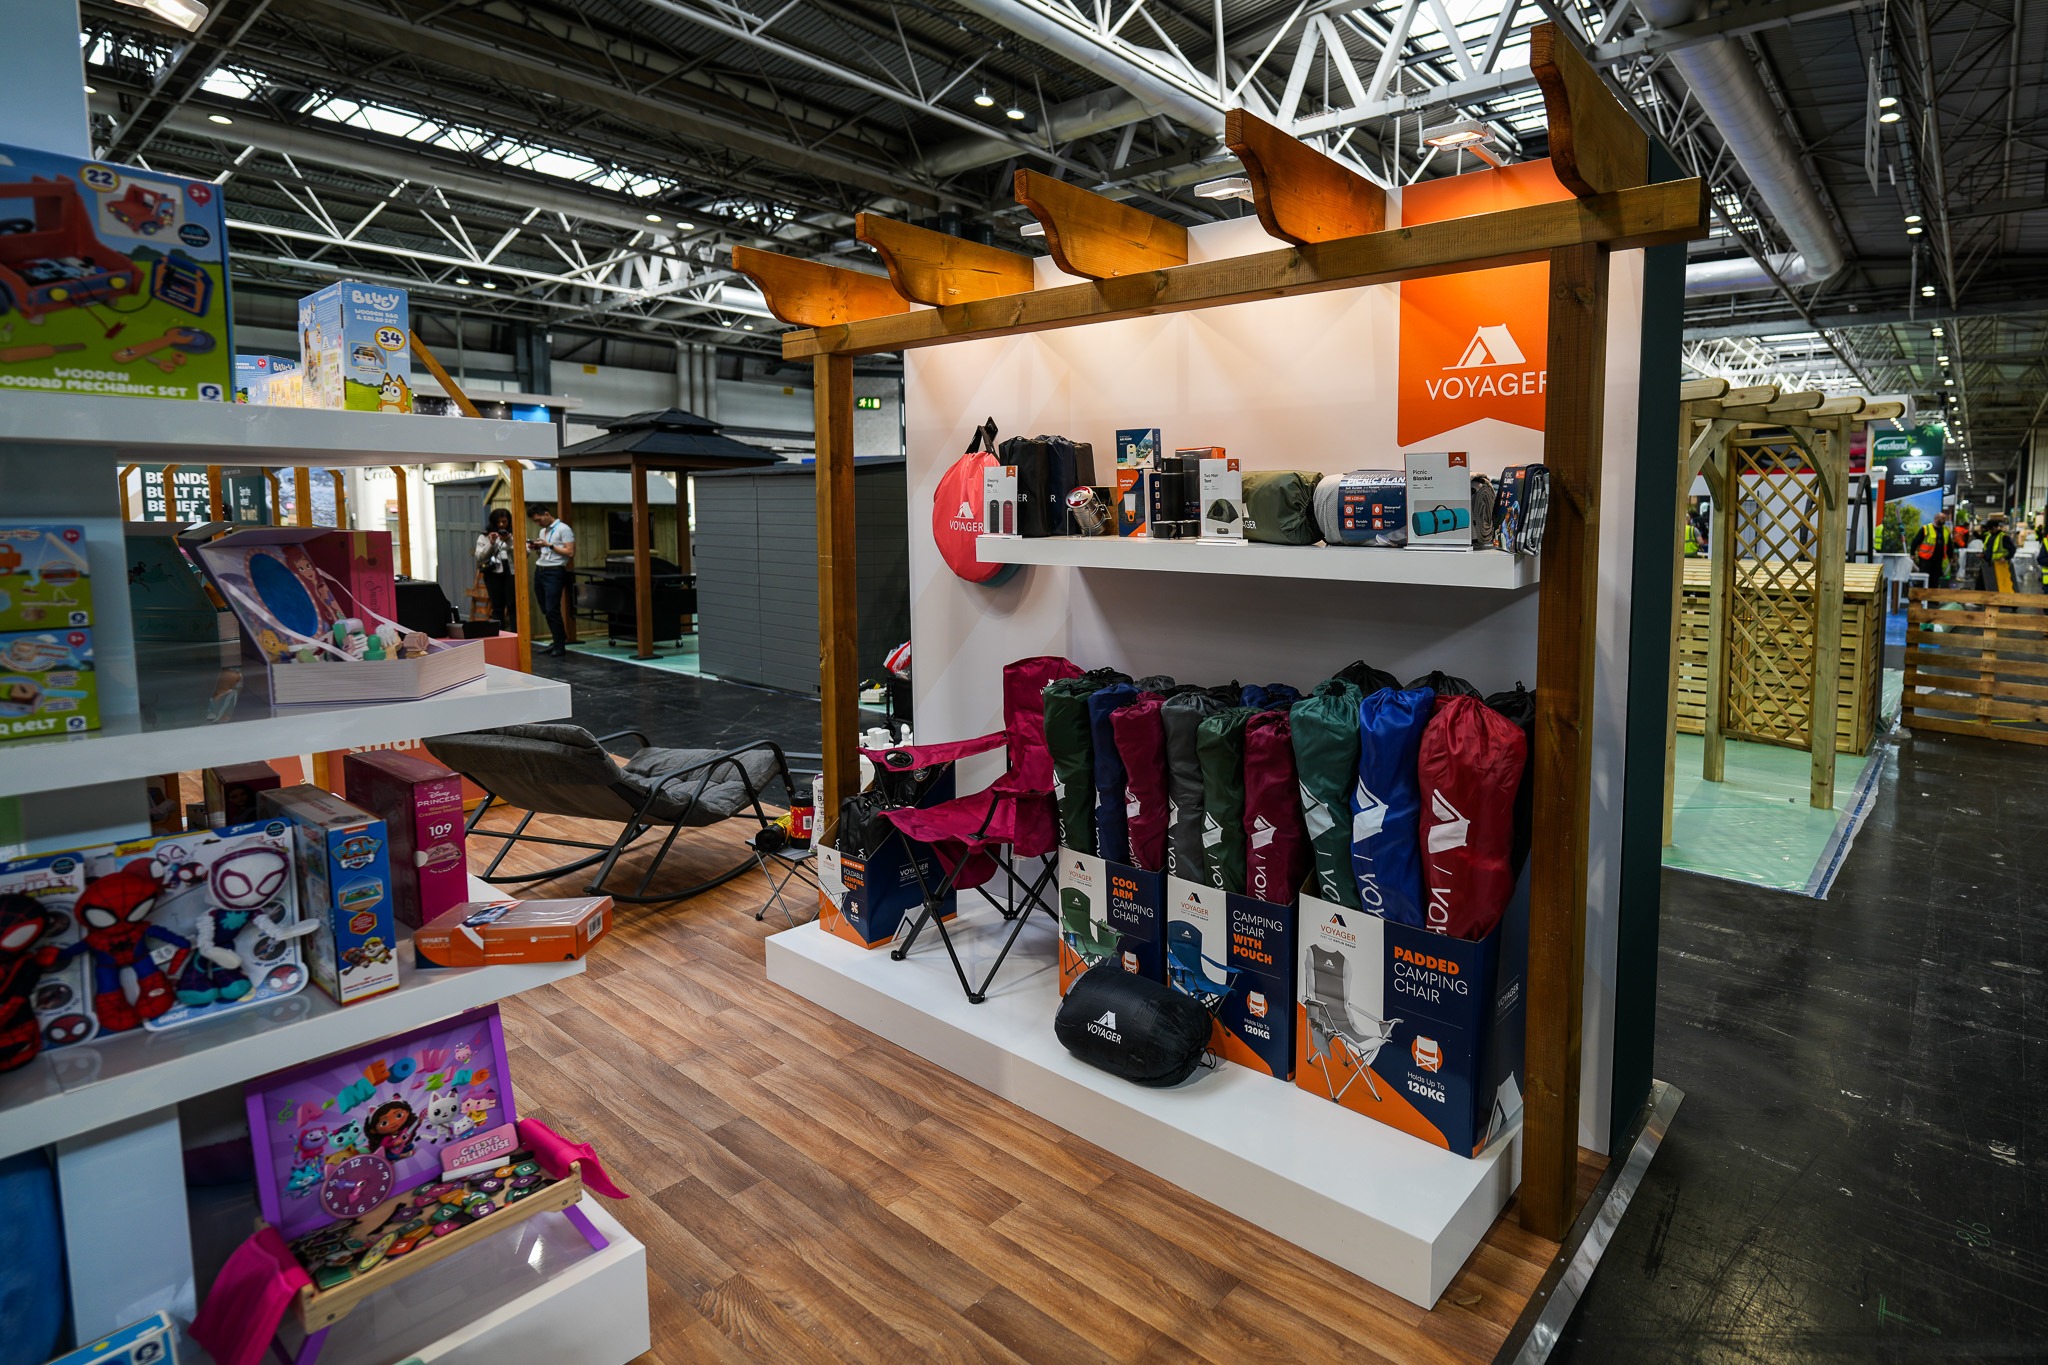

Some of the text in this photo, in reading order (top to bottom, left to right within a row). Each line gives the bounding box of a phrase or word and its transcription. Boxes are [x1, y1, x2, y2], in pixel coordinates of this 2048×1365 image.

[87, 169, 114, 186] 22
[380, 331, 402, 345] 34
[146, 486, 190, 499] BULT
[147, 500, 199, 512] BEIEF
[416, 794, 461, 807] PRINCESS
[429, 823, 452, 836] 109
[331, 838, 383, 860] PAW
[1111, 876, 1139, 891] COOL
[1112, 888, 1134, 901] ARM
[1112, 898, 1154, 918] CAMPING
[1112, 908, 1140, 925] CHAIR
[1180, 902, 1209, 916] VOYAGER
[1232, 910, 1283, 932] CAMPING
[1232, 922, 1265, 939] CHAIR
[1320, 924, 1356, 943] VOYAGER
[1233, 933, 1262, 949] WITH
[1233, 945, 1272, 965] POUCH
[1394, 946, 1460, 976] PADDED
[1394, 962, 1468, 996] CAMPING
[1394, 978, 1441, 1004] CHAIR
[1244, 1017, 1256, 1027] Holds
[1087, 1022, 1122, 1045] VOYAGER
[1244, 1023, 1270, 1040] 120KG
[1407, 1071, 1445, 1091] Holds Up To
[1407, 1081, 1446, 1103] 120KG
[451, 1138, 511, 1168] DOLLHOUSE
[460, 1135, 501, 1156] GABBY'S
[350, 1158, 361, 1168] 12
[382, 1171, 390, 1180] 3
[325, 1191, 334, 1200] 9
[371, 1196, 378, 1204] 5
[357, 1204, 365, 1213] 6
